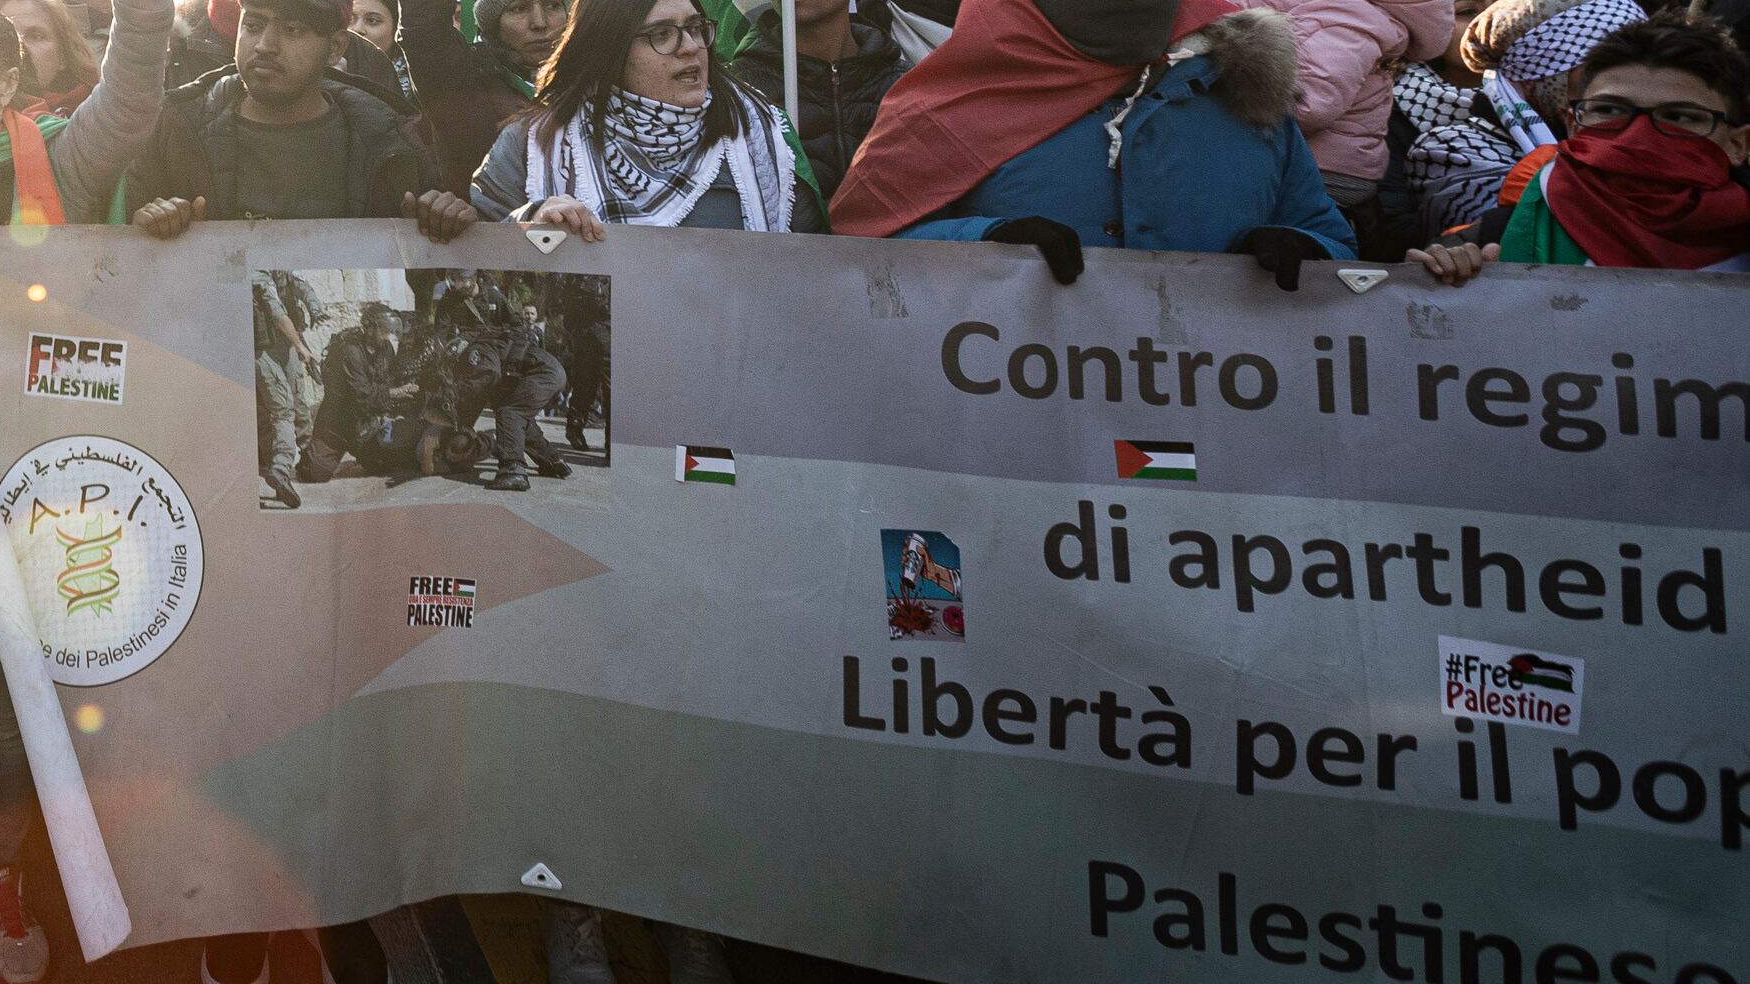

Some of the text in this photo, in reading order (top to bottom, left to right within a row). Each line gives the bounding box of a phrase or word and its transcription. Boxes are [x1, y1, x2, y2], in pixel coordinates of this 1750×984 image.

[30, 334, 124, 375] FREE
[27, 374, 120, 401] PALESTINE
[941, 321, 1750, 453] Contro il regim
[29, 483, 148, 535] A.P.I.
[168, 543, 188, 589] Italia
[410, 576, 453, 595] FREE
[1043, 500, 1729, 636] di apartheid
[162, 593, 181, 611] in
[407, 604, 473, 629] PALESTINE
[55, 647, 80, 669] dei
[86, 608, 171, 669] Palestinesi
[1445, 652, 1524, 691] #Free
[1446, 680, 1572, 727] Palestine
[842, 654, 1192, 770] Libertà
[1236, 718, 1418, 795] per
[1454, 716, 1512, 804] il
